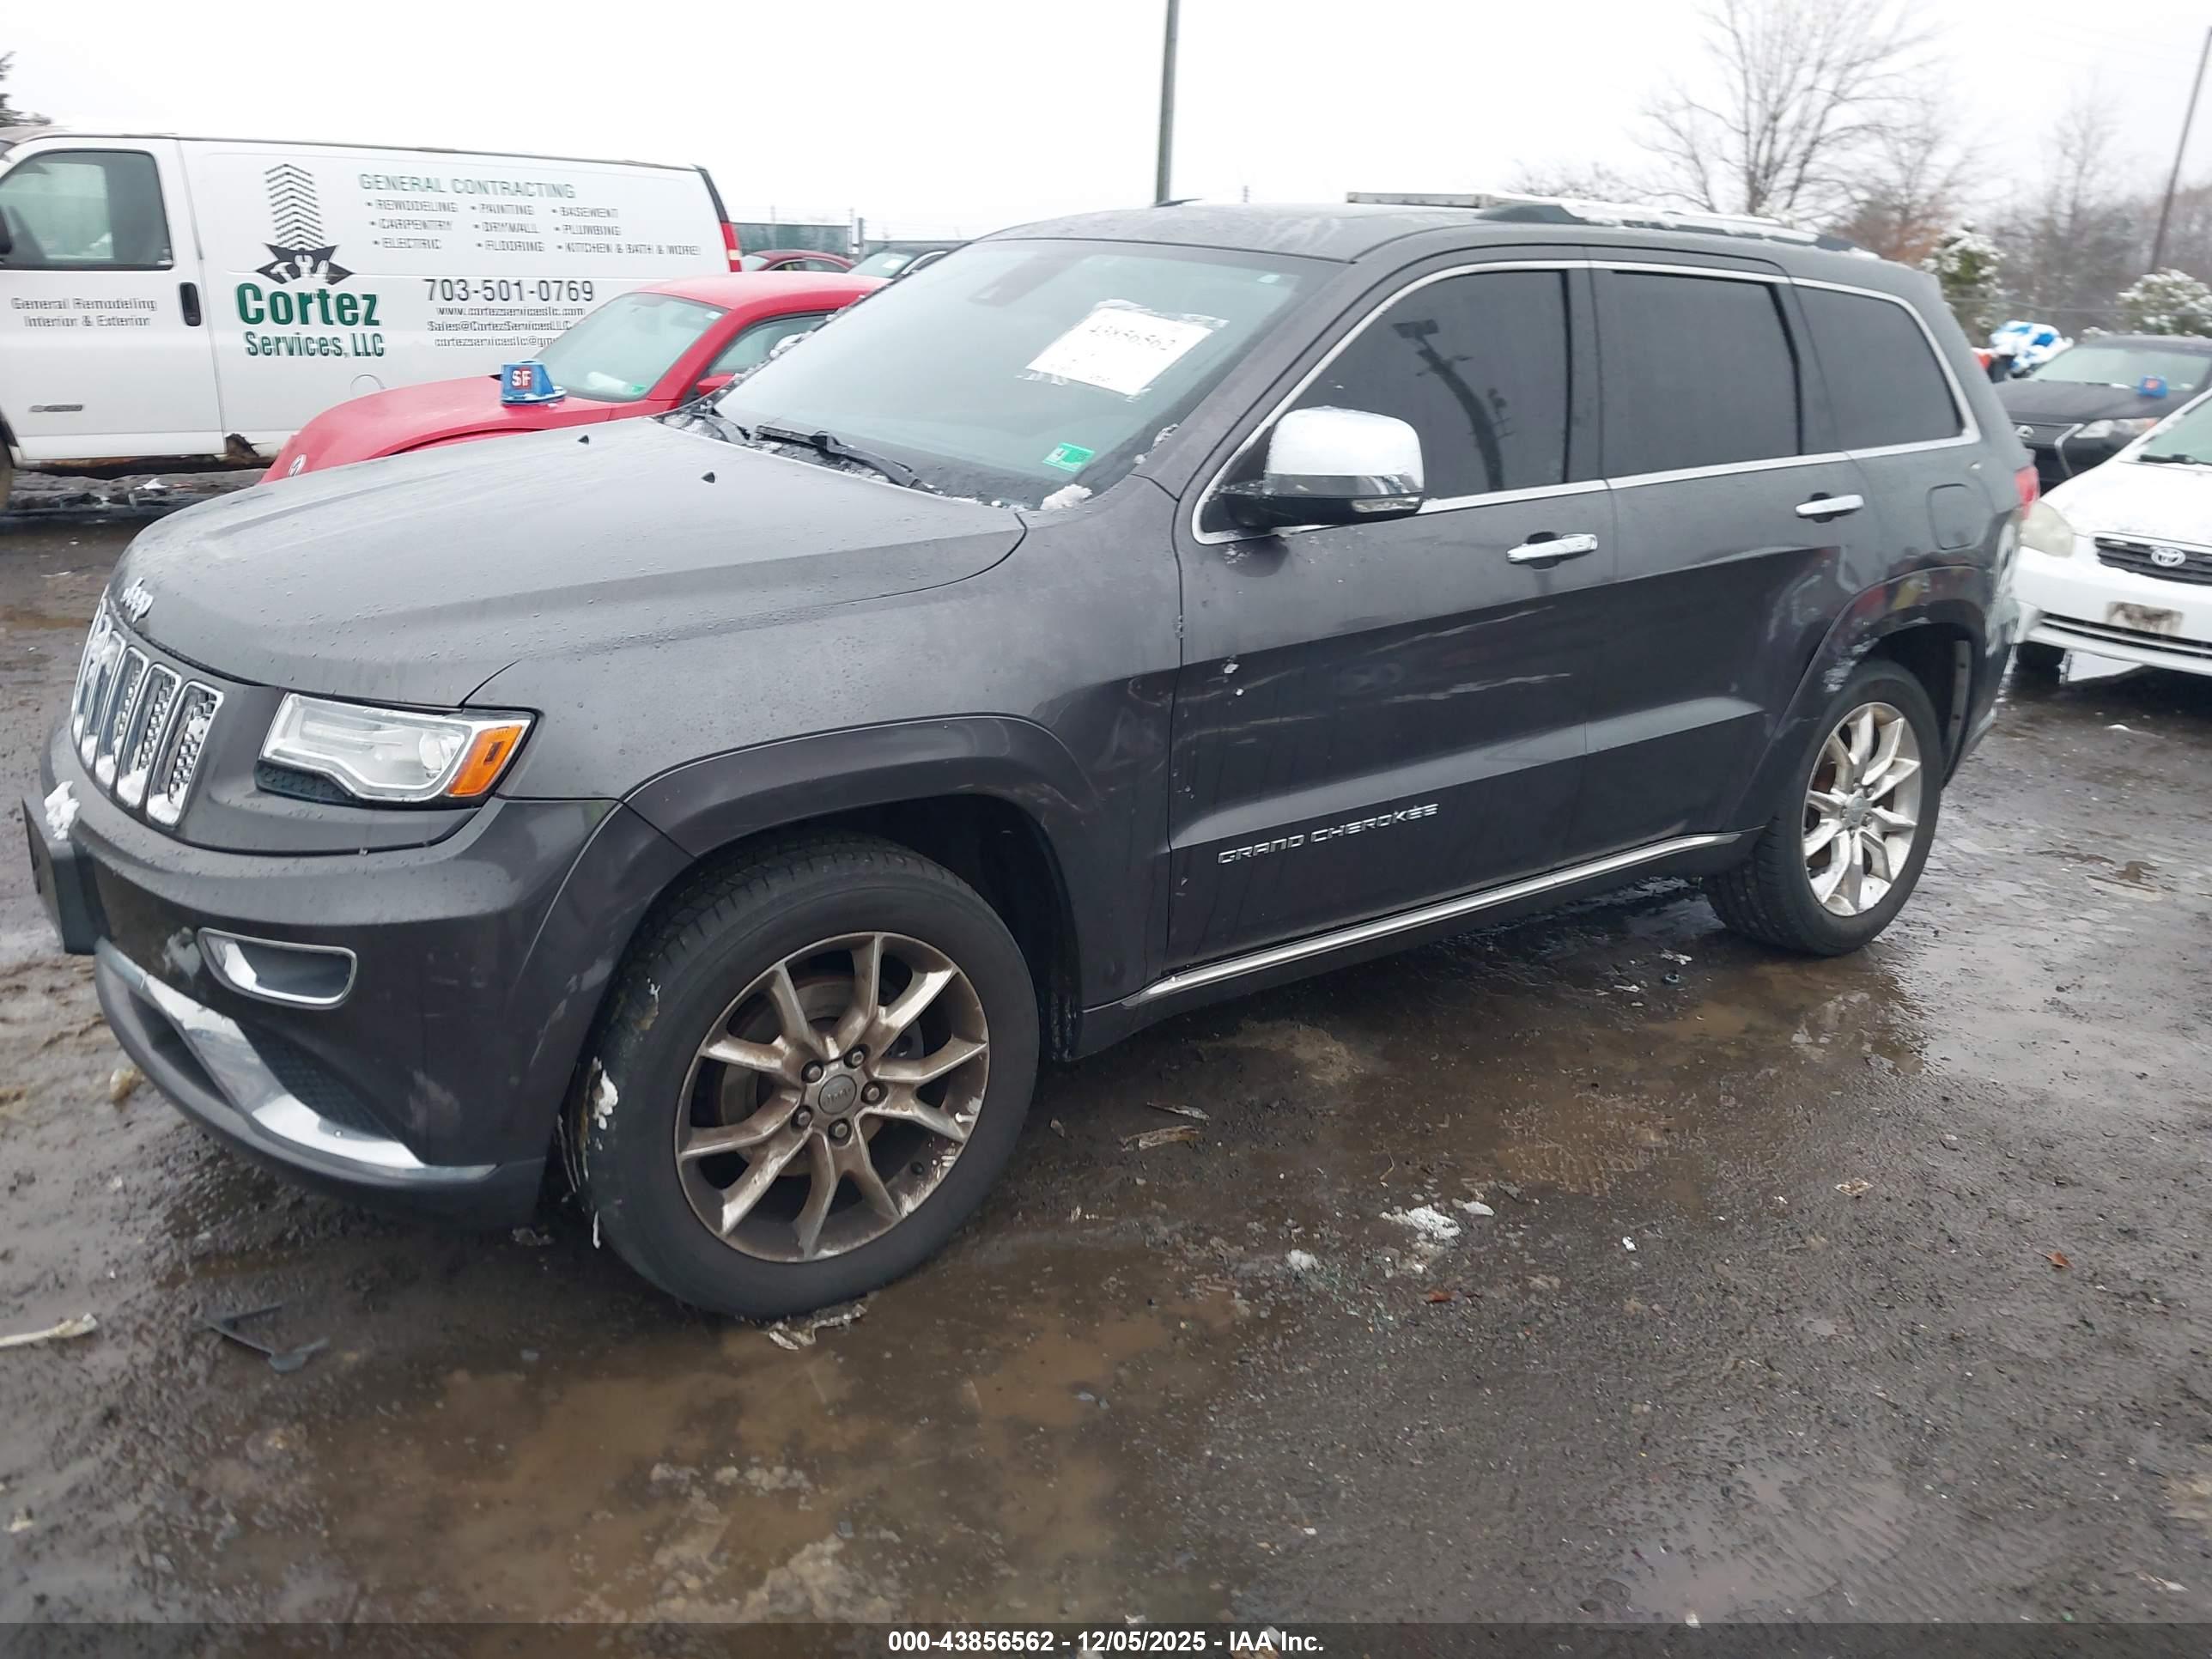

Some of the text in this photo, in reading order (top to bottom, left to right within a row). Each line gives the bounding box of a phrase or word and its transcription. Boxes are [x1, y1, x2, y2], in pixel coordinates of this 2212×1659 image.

[359, 173, 575, 198] GENERAL CONTRACTING
[374, 199, 459, 213] REMODELING
[479, 204, 534, 216] PAINTING
[559, 206, 618, 218] BASEMENT
[379, 218, 453, 231] CARPENTRY
[482, 221, 539, 234] DRYWALL
[562, 224, 622, 236] PLUMBING
[382, 237, 442, 249] ELECTRIC
[484, 240, 545, 252] FLOORING
[565, 242, 613, 254] KITCHEN
[626, 244, 653, 255] BATH
[423, 278, 593, 301] 703-501-0769
[10, 297, 157, 312] General Remodeling
[237, 283, 380, 326] Cortez
[24, 315, 150, 327] Interior & Exterior
[245, 331, 385, 358] Services, LLC
[511, 370, 532, 386] SF
[1216, 804, 1440, 864] GRAND CHEROKEE
